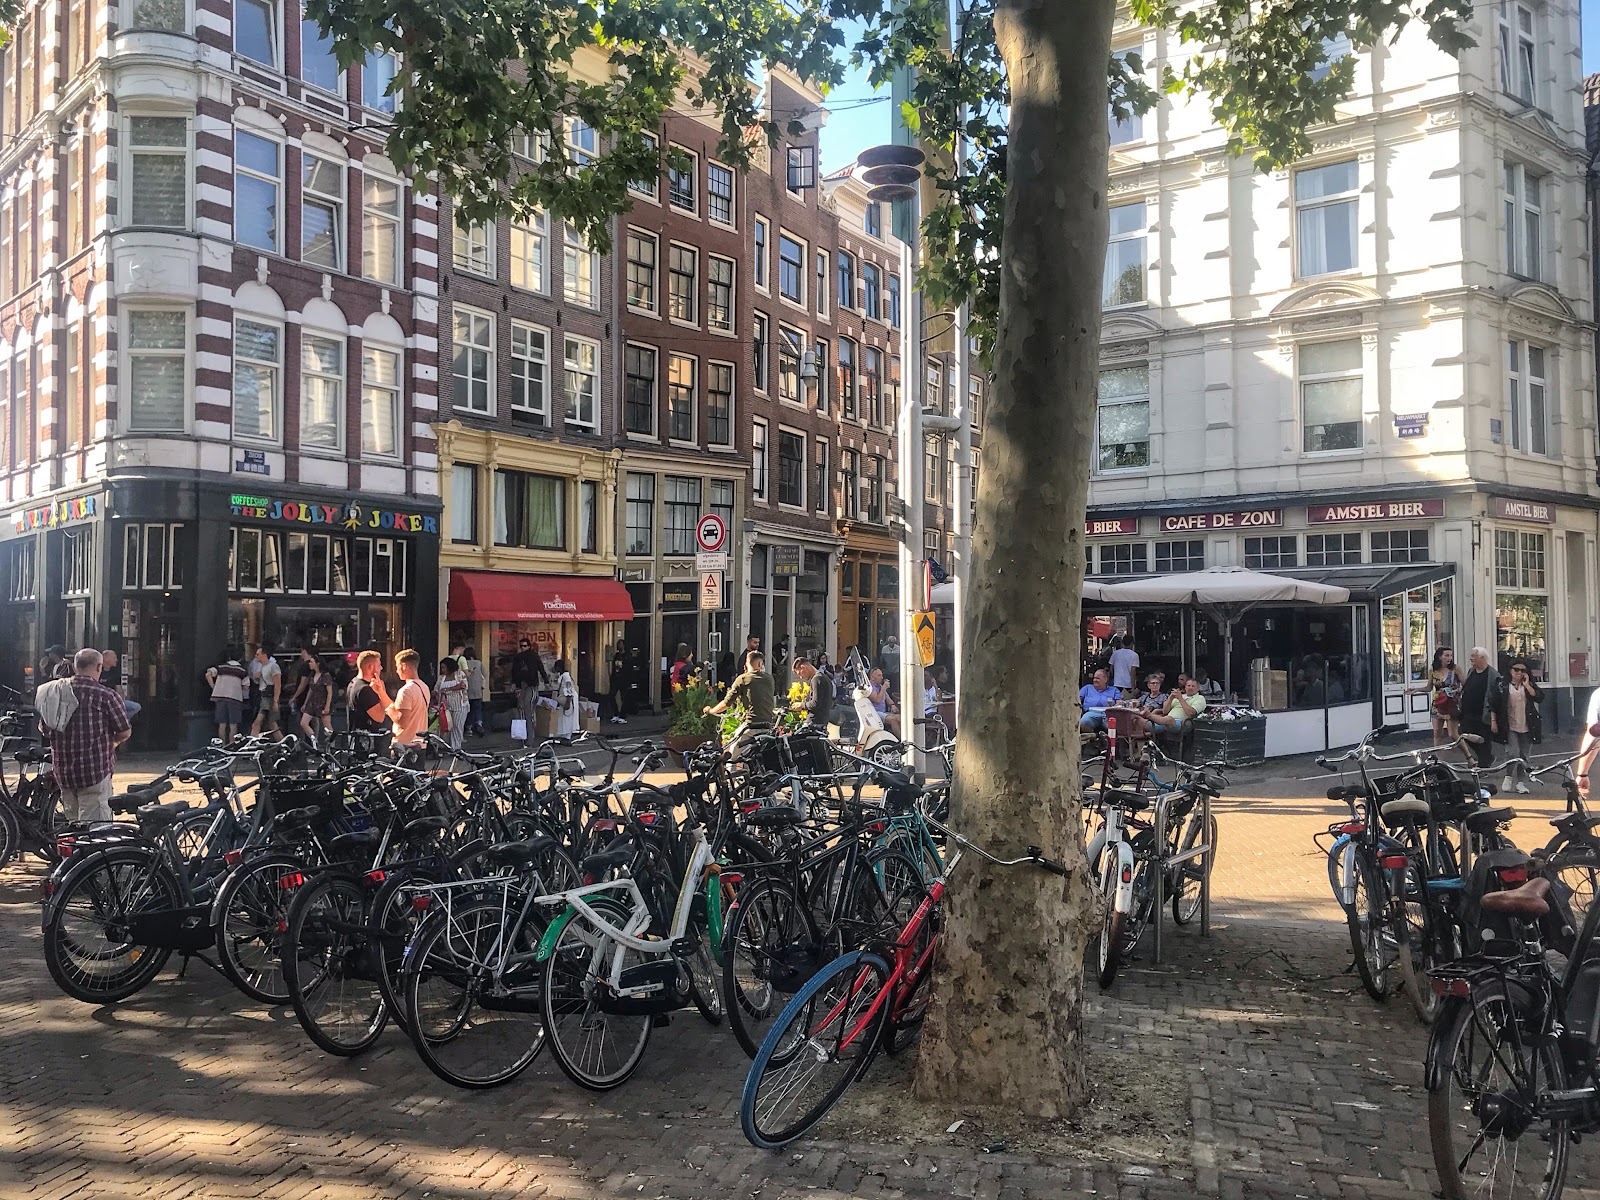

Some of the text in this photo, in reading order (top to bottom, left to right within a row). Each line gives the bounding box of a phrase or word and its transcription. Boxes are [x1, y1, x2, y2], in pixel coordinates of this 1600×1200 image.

[61, 495, 94, 521] JOKER
[231, 495, 269, 507] COFFEESHOP
[230, 501, 437, 534] THE JOLLY JOKER
[1325, 502, 1425, 520] AMSTEL BIER
[1505, 502, 1549, 520] AMSTEL BIER
[1093, 521, 1122, 534] BIER
[1165, 511, 1276, 530] CAFE DE ZON
[491, 630, 556, 643] TOOMAN
